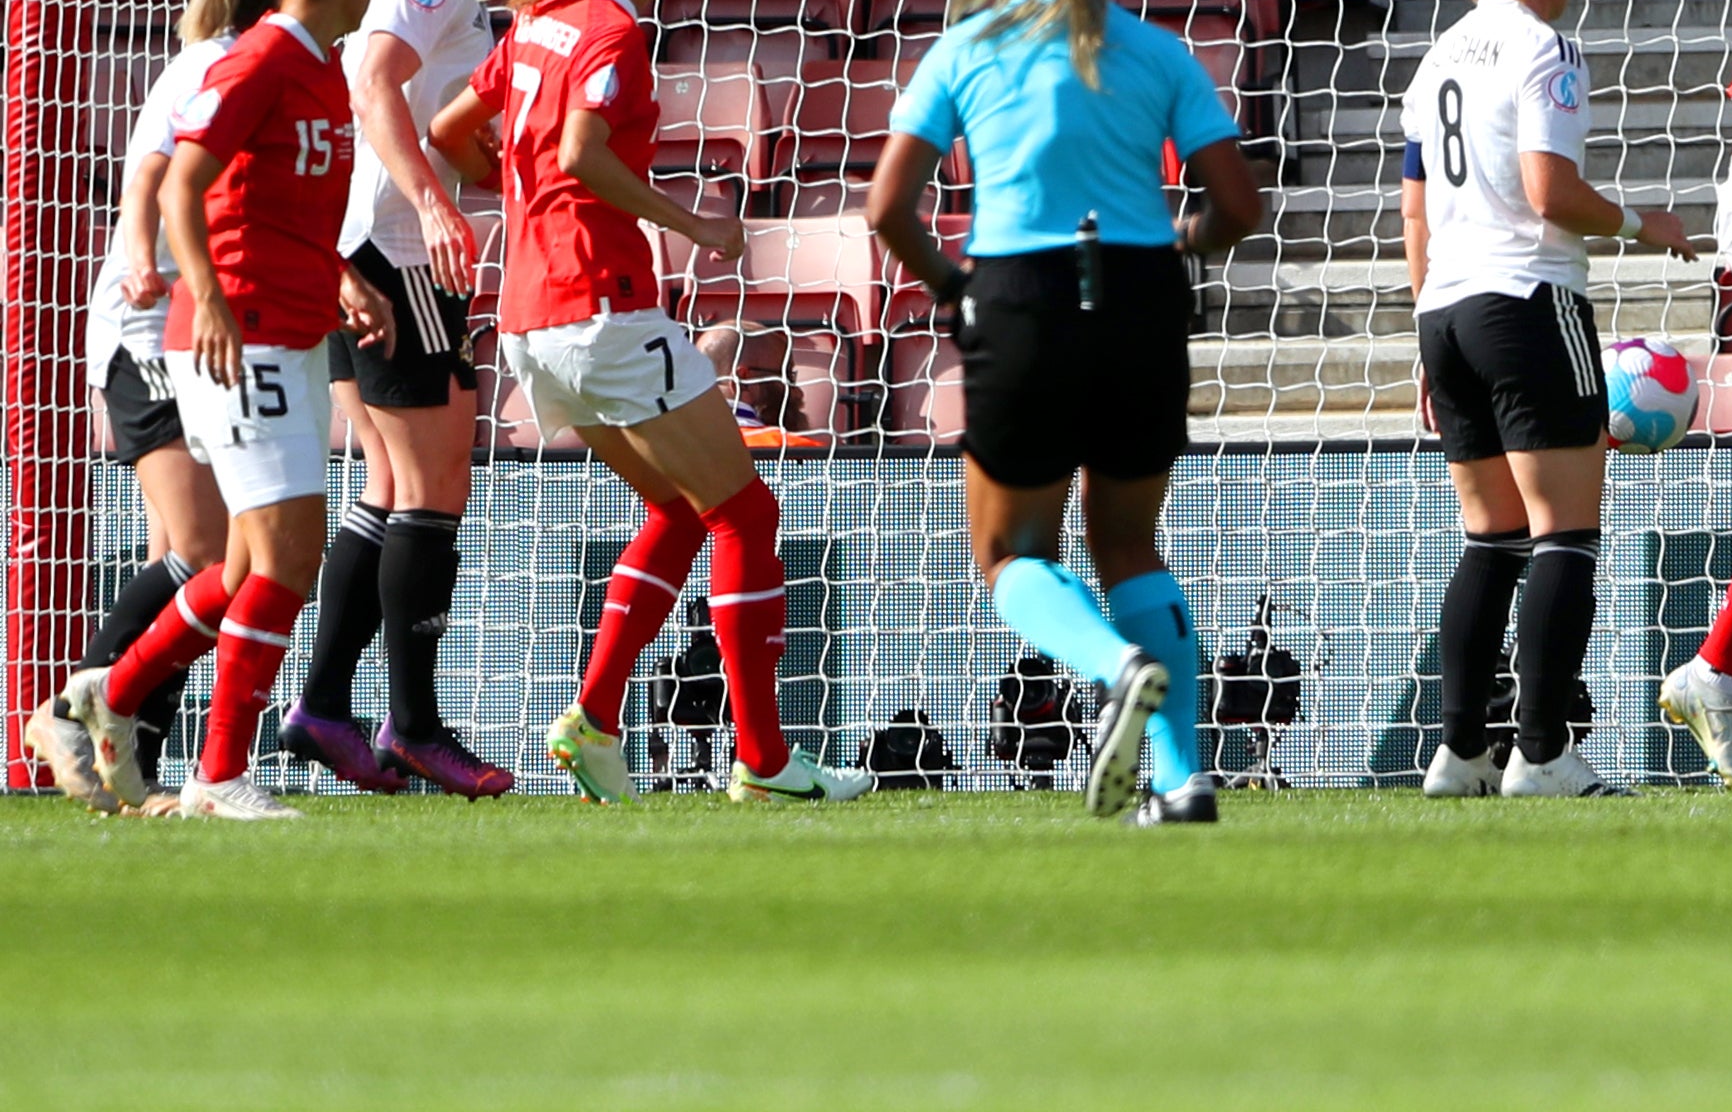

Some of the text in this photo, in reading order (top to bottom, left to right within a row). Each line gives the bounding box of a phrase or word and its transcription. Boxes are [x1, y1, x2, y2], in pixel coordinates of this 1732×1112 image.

[511, 62, 542, 173] 7
[1438, 78, 1468, 188] 8
[294, 118, 332, 176] 15
[239, 363, 289, 418] 15
[644, 336, 675, 392] 7
